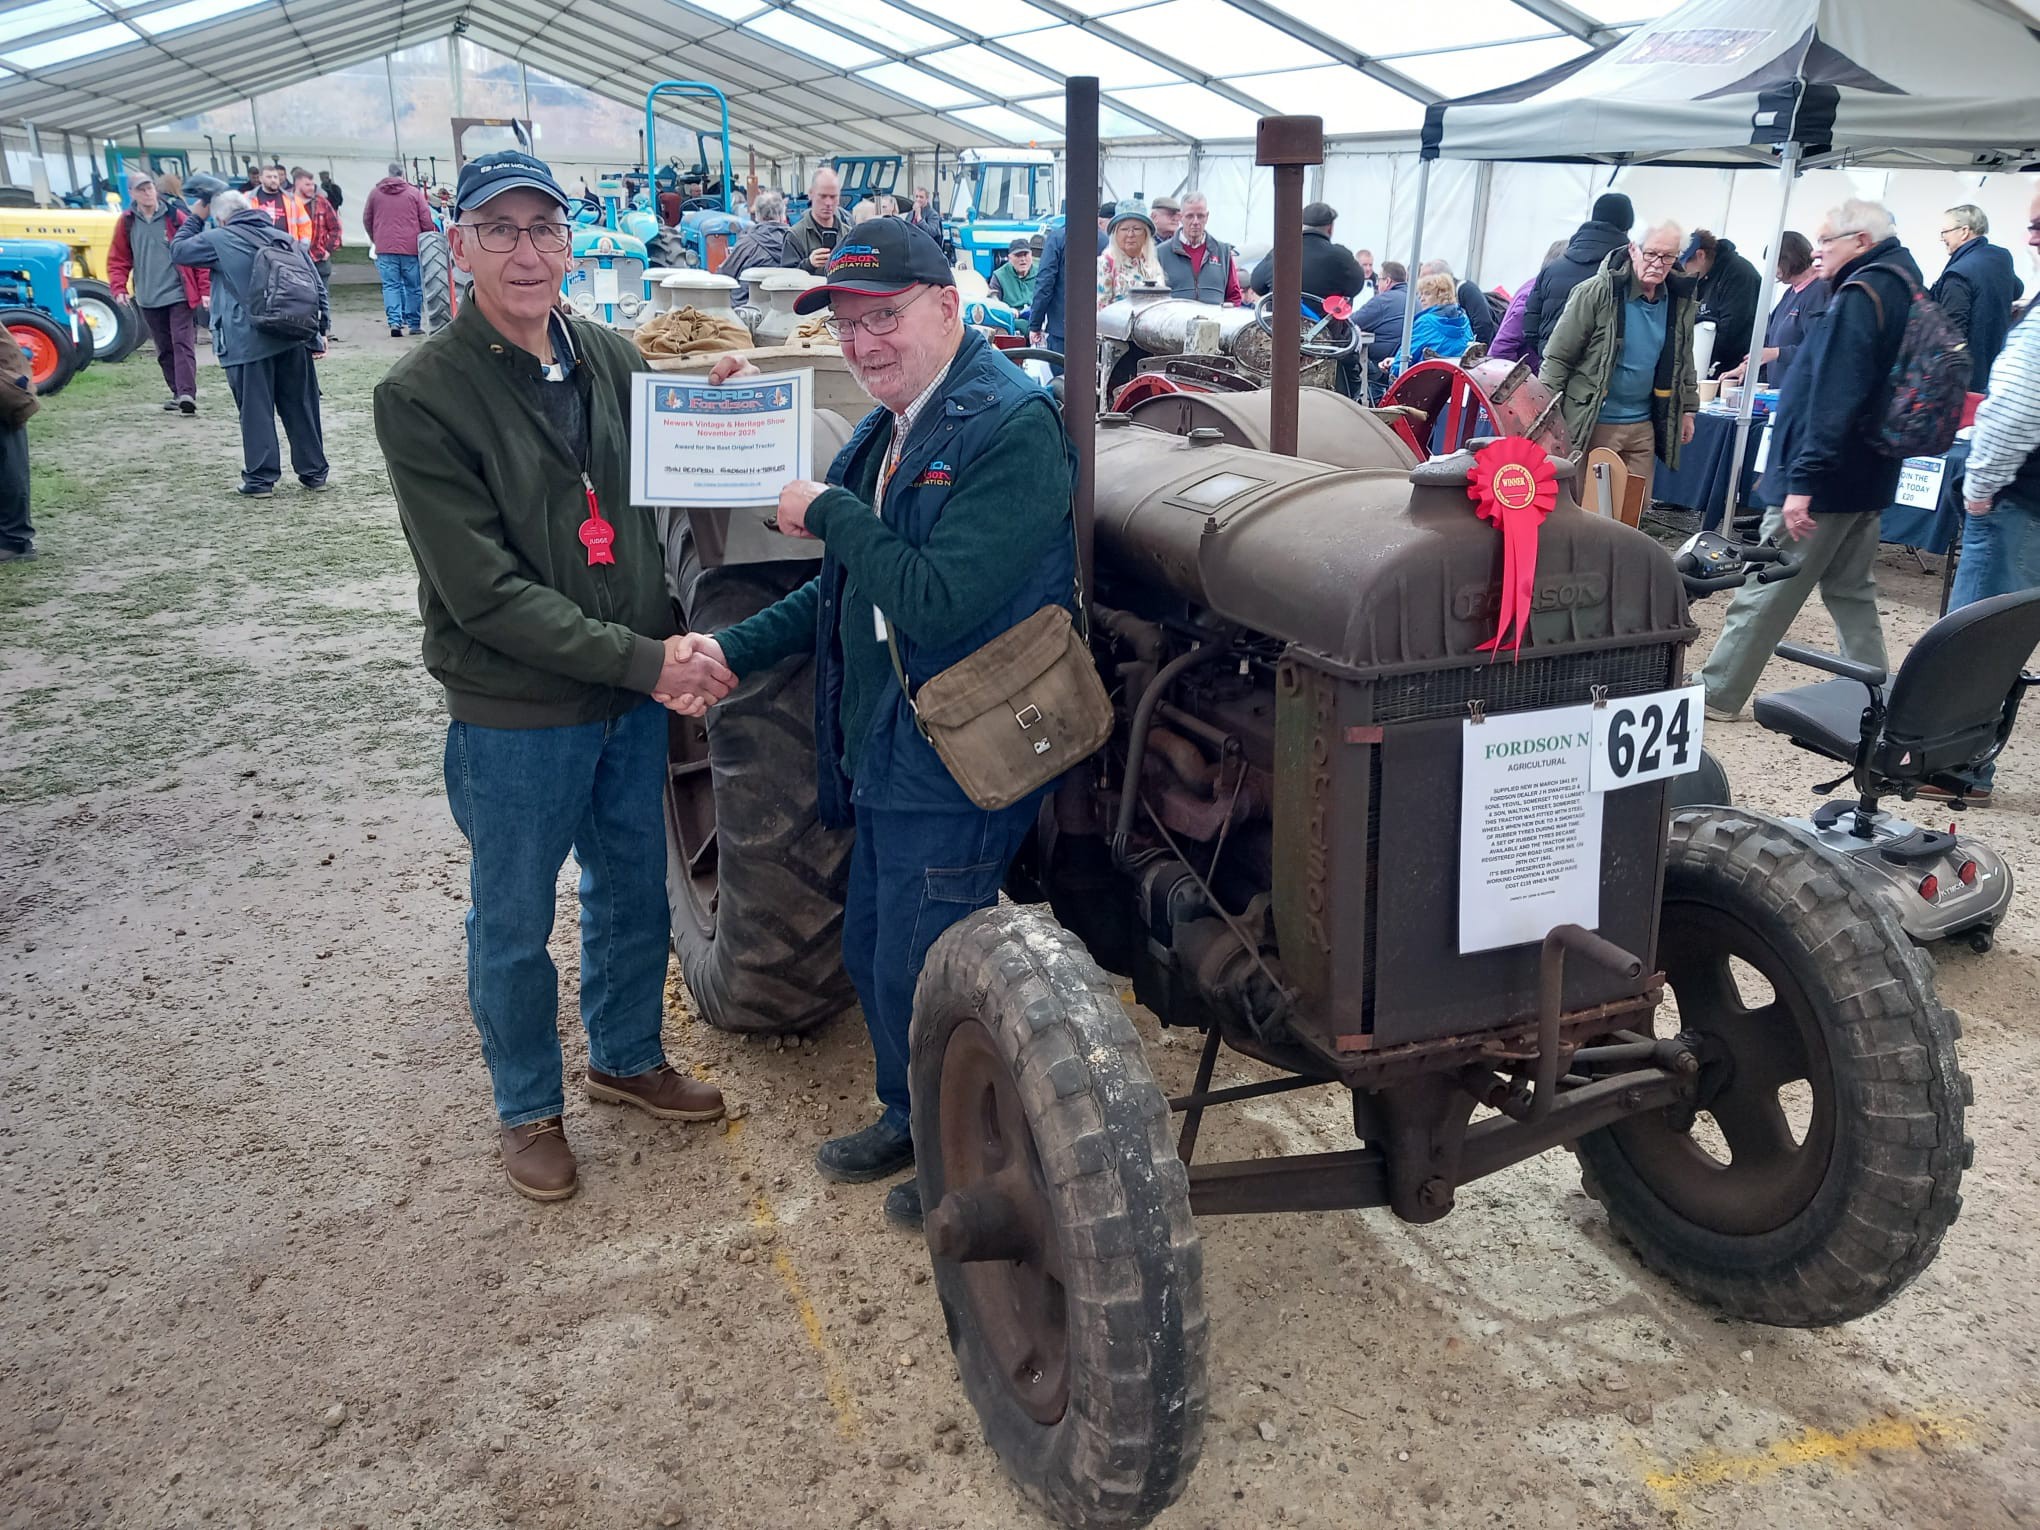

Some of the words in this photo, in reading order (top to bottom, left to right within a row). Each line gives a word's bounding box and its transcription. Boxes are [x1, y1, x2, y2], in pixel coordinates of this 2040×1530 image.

[511, 162, 545, 174] HOLL
[689, 389, 754, 400] FORD
[689, 398, 764, 410] Fordson
[664, 418, 694, 426] Newark
[696, 420, 725, 429] Vintage
[735, 420, 765, 428] Heritage
[731, 444, 754, 452] Original
[1502, 477, 1526, 487] WINNER
[1900, 472, 1913, 480] OIN
[1915, 474, 1928, 482] THE
[1906, 482, 1930, 493] TODAY
[1464, 583, 1600, 614] FOSON
[1608, 697, 1690, 779] 624
[1485, 734, 1573, 760] FORDSON
[1576, 732, 1590, 748] N
[1507, 757, 1566, 772] AGRICULTURAL
[1494, 786, 1520, 794] SUPPLIED
[1490, 794, 1516, 802] FORDSON
[1517, 790, 1538, 798] DEALER
[1524, 796, 1552, 804] SOMERSET
[1498, 815, 1522, 823] TRACTOR
[1494, 830, 1517, 838] RUBBER
[1536, 824, 1554, 832] DURING
[1556, 828, 1576, 836] BECAME
[1489, 846, 1518, 854] AVAILABLE
[1542, 838, 1565, 846] TRACTOR
[1482, 854, 1514, 862] REGISTERED
[1516, 864, 1545, 872] PRESERVED
[1552, 858, 1575, 866] ORIGINAL
[1486, 876, 1512, 884] WORKING
[1513, 871, 1540, 880] CONDITION
[1546, 866, 1564, 874] WOULD
